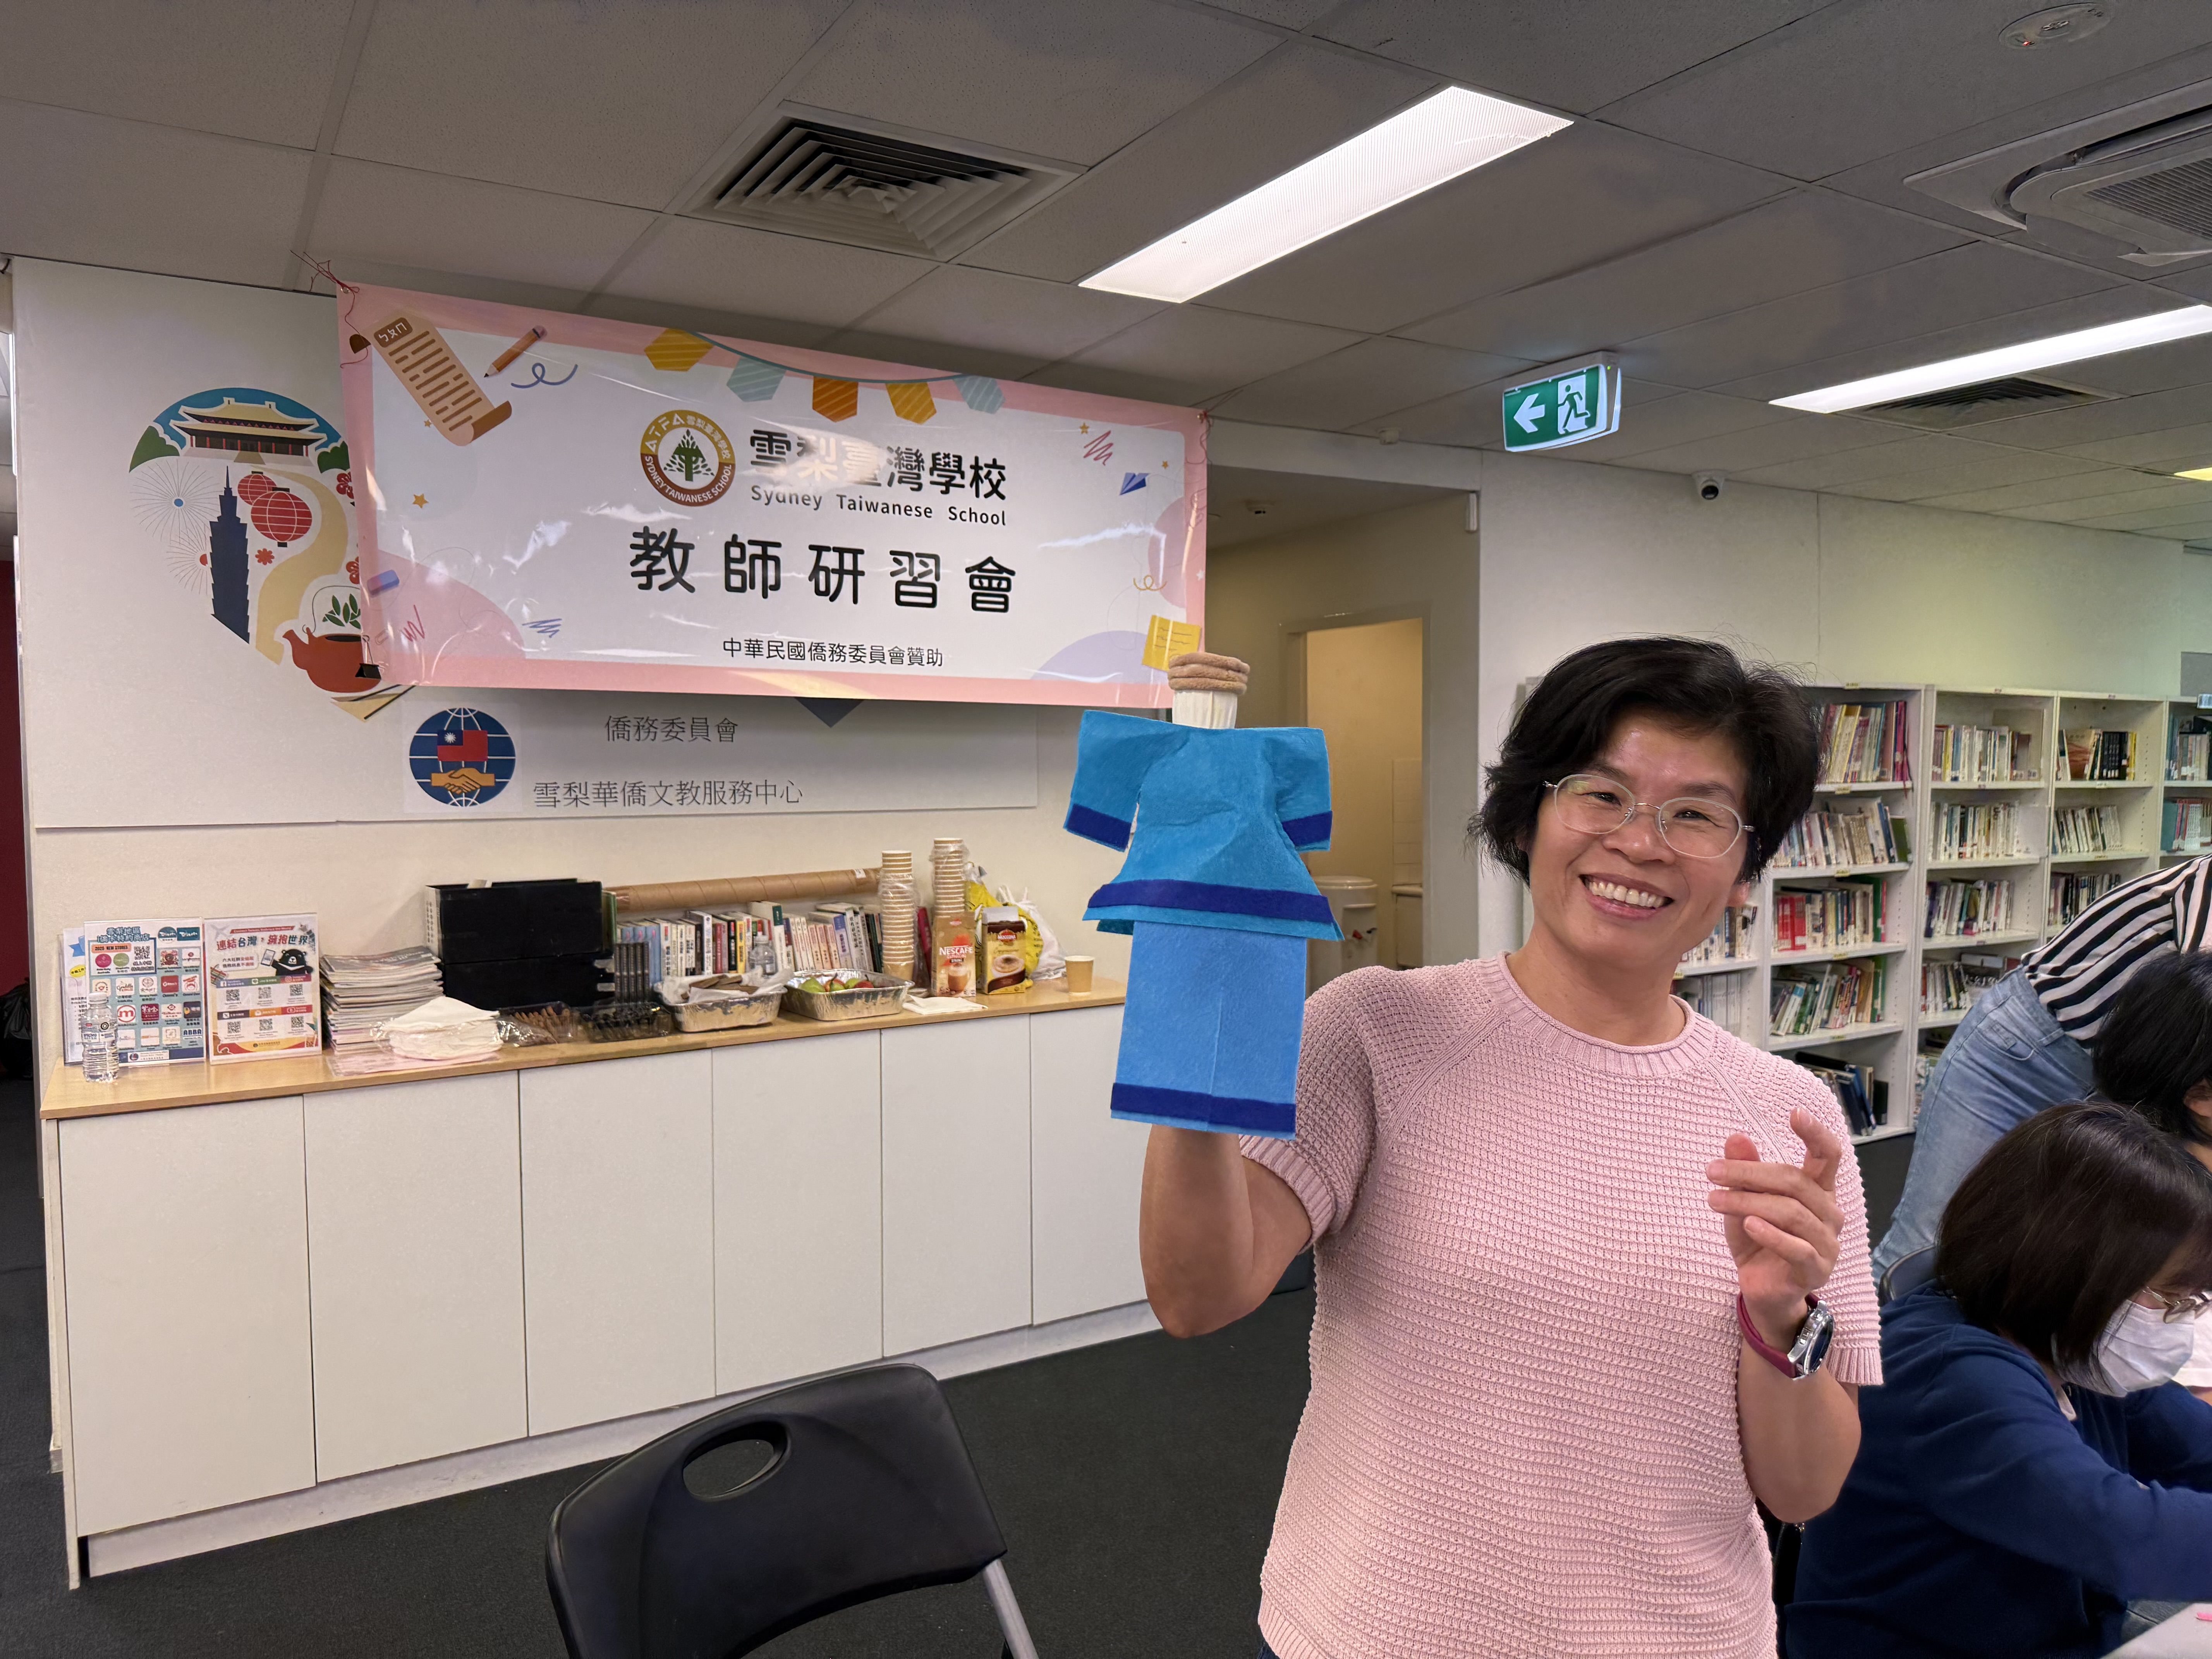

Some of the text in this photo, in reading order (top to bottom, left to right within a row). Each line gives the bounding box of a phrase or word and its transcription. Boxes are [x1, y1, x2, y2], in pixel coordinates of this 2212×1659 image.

[645, 456, 732, 503] SYDNEY TAIWANESE SCHOOL
[751, 485, 1006, 526] Sydney Taiwanese School
[629, 526, 1016, 613] 教師研習會
[723, 637, 943, 667] 中華民國僑務委員會贊助
[604, 715, 738, 743] 僑務委員會
[533, 780, 803, 809] 雪梨華僑文教服務中心
